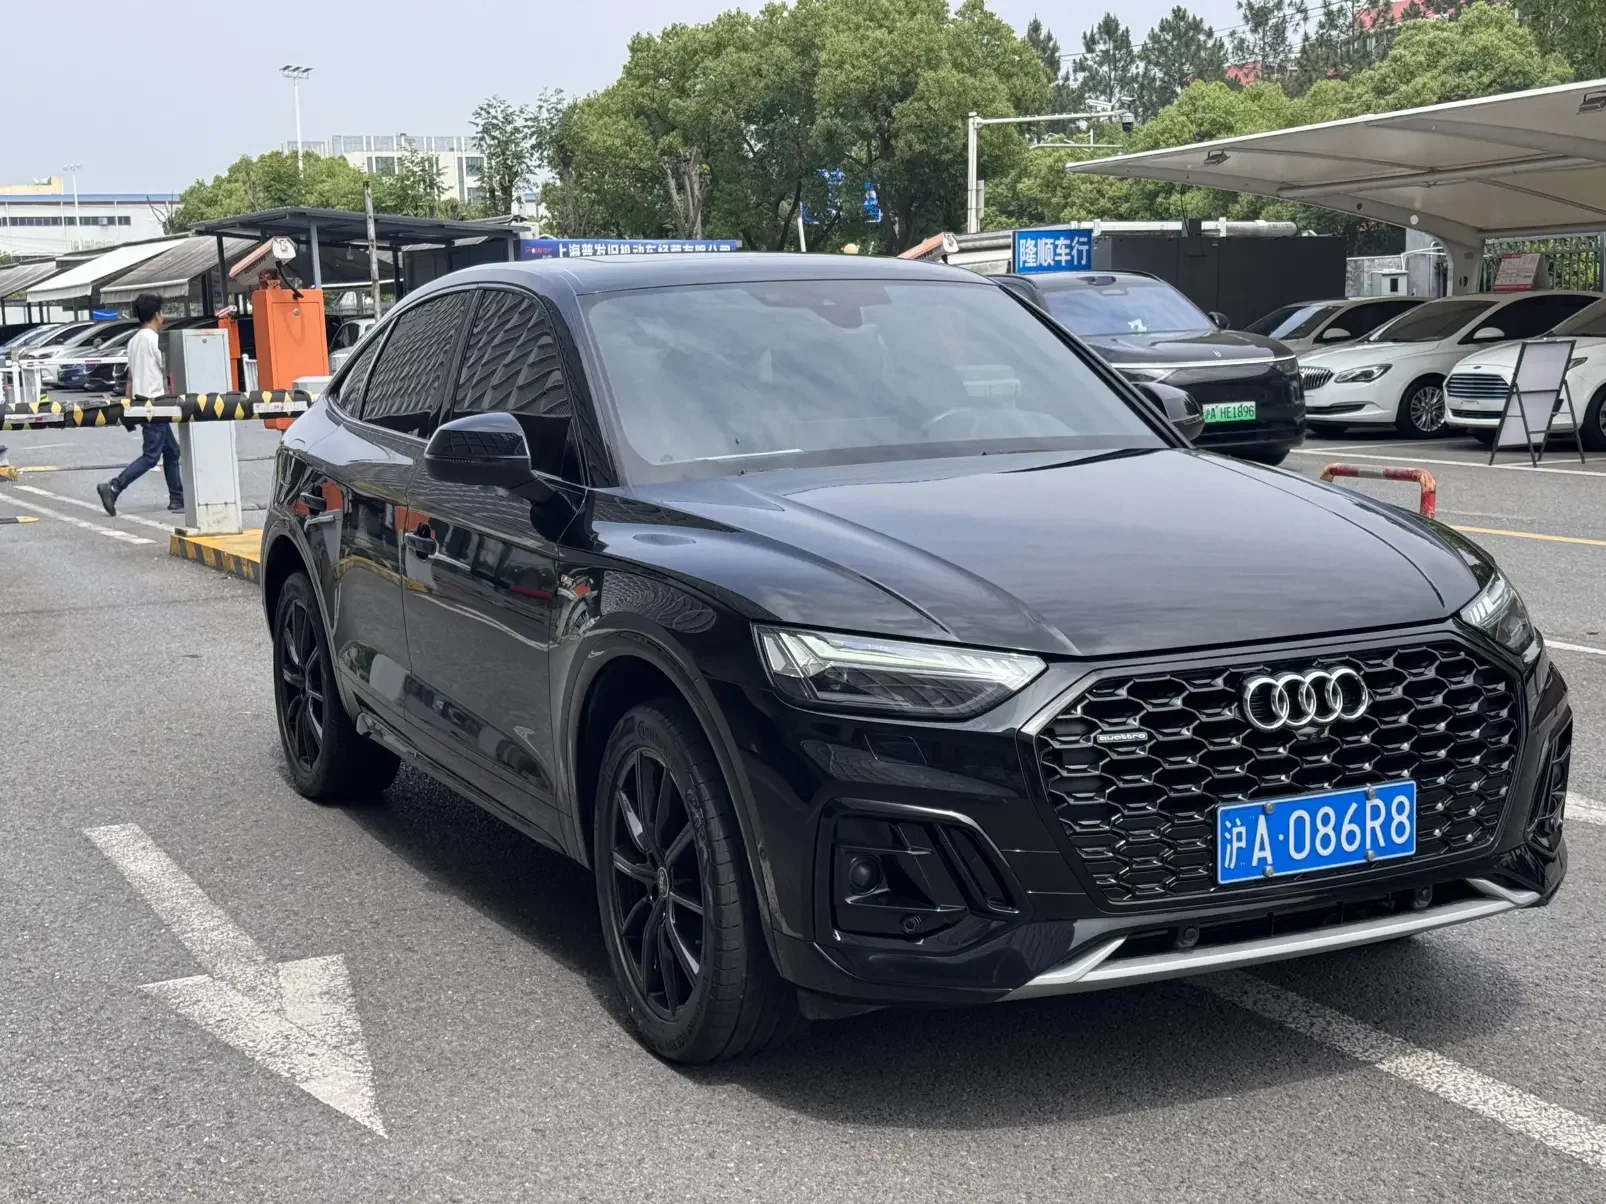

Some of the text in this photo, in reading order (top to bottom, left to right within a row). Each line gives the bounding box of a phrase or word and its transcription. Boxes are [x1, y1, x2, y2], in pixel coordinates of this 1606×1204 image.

[1020, 236, 1089, 268] 隆顺车行
[1099, 733, 1146, 742] quattro
